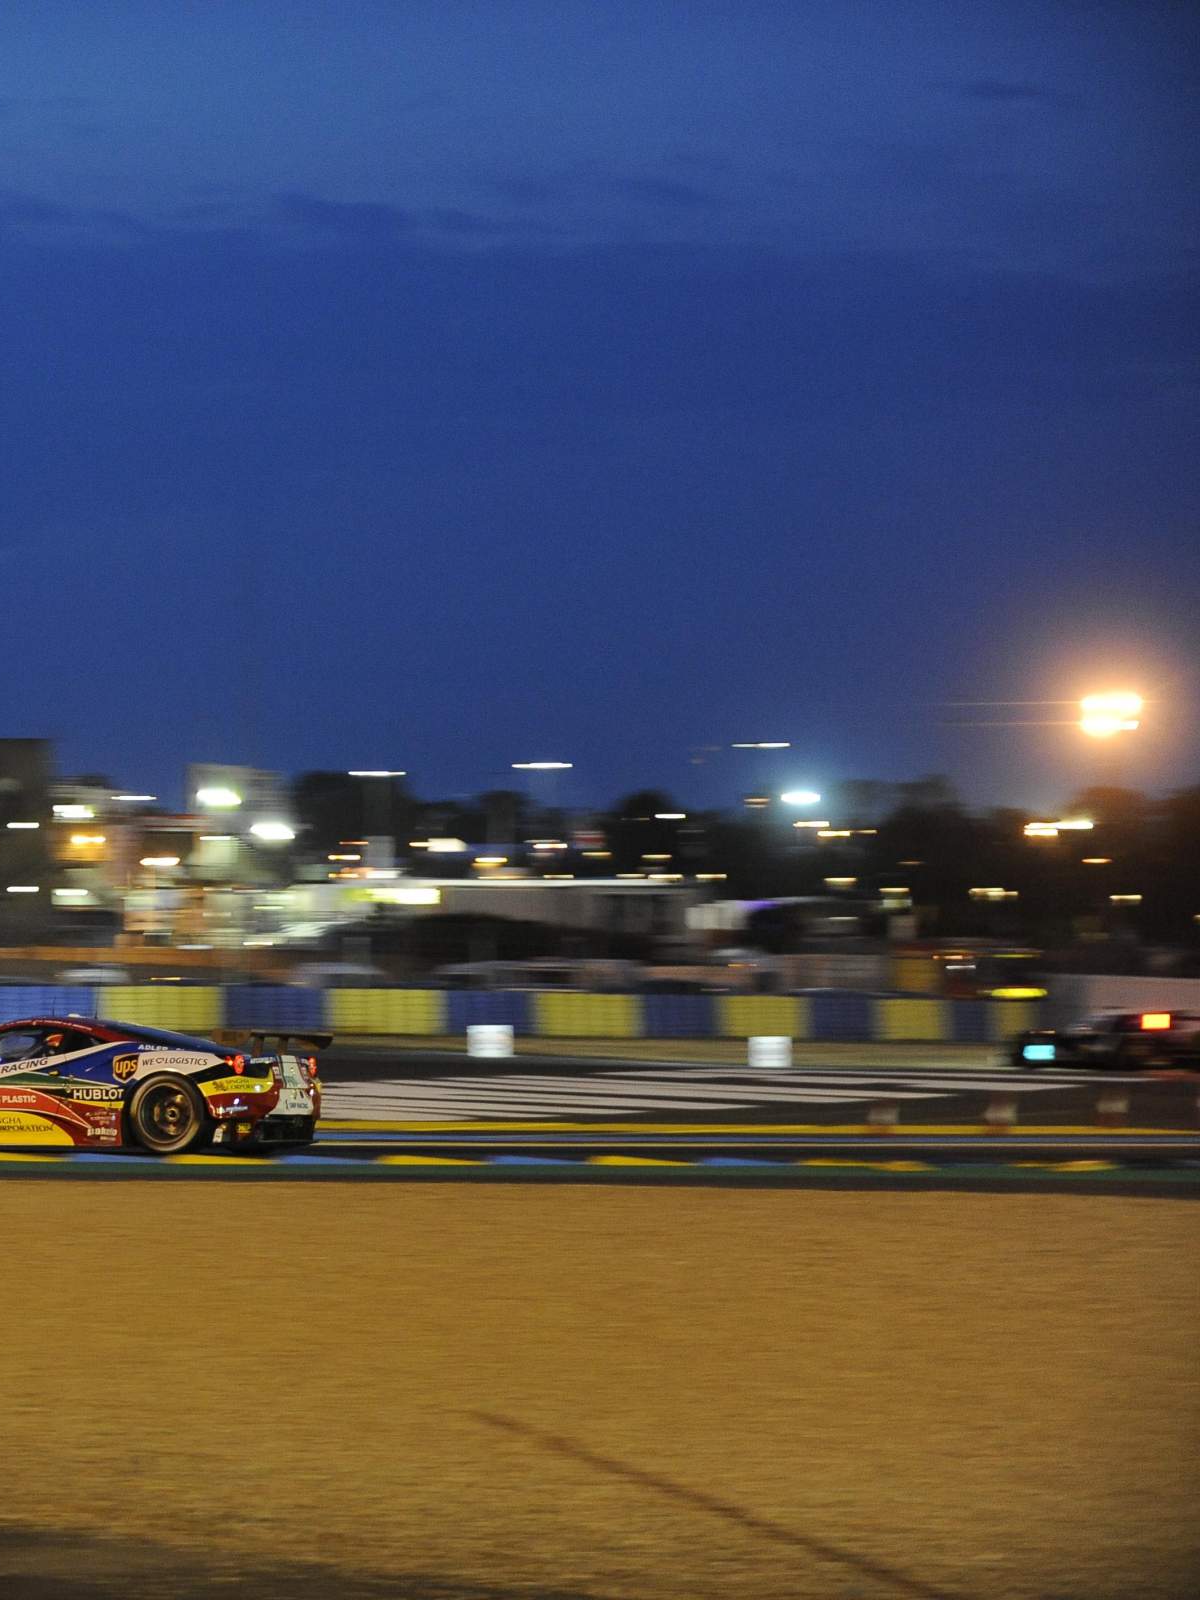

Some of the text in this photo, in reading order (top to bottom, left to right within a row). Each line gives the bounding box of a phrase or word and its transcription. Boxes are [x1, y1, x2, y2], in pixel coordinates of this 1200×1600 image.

[0, 1057, 48, 1075] RACING
[142, 1056, 208, 1067] WE LOGISTICS
[116, 1059, 137, 1078] ups
[2, 1095, 37, 1104] PLASTIC
[73, 1089, 124, 1100] HUBLOT
